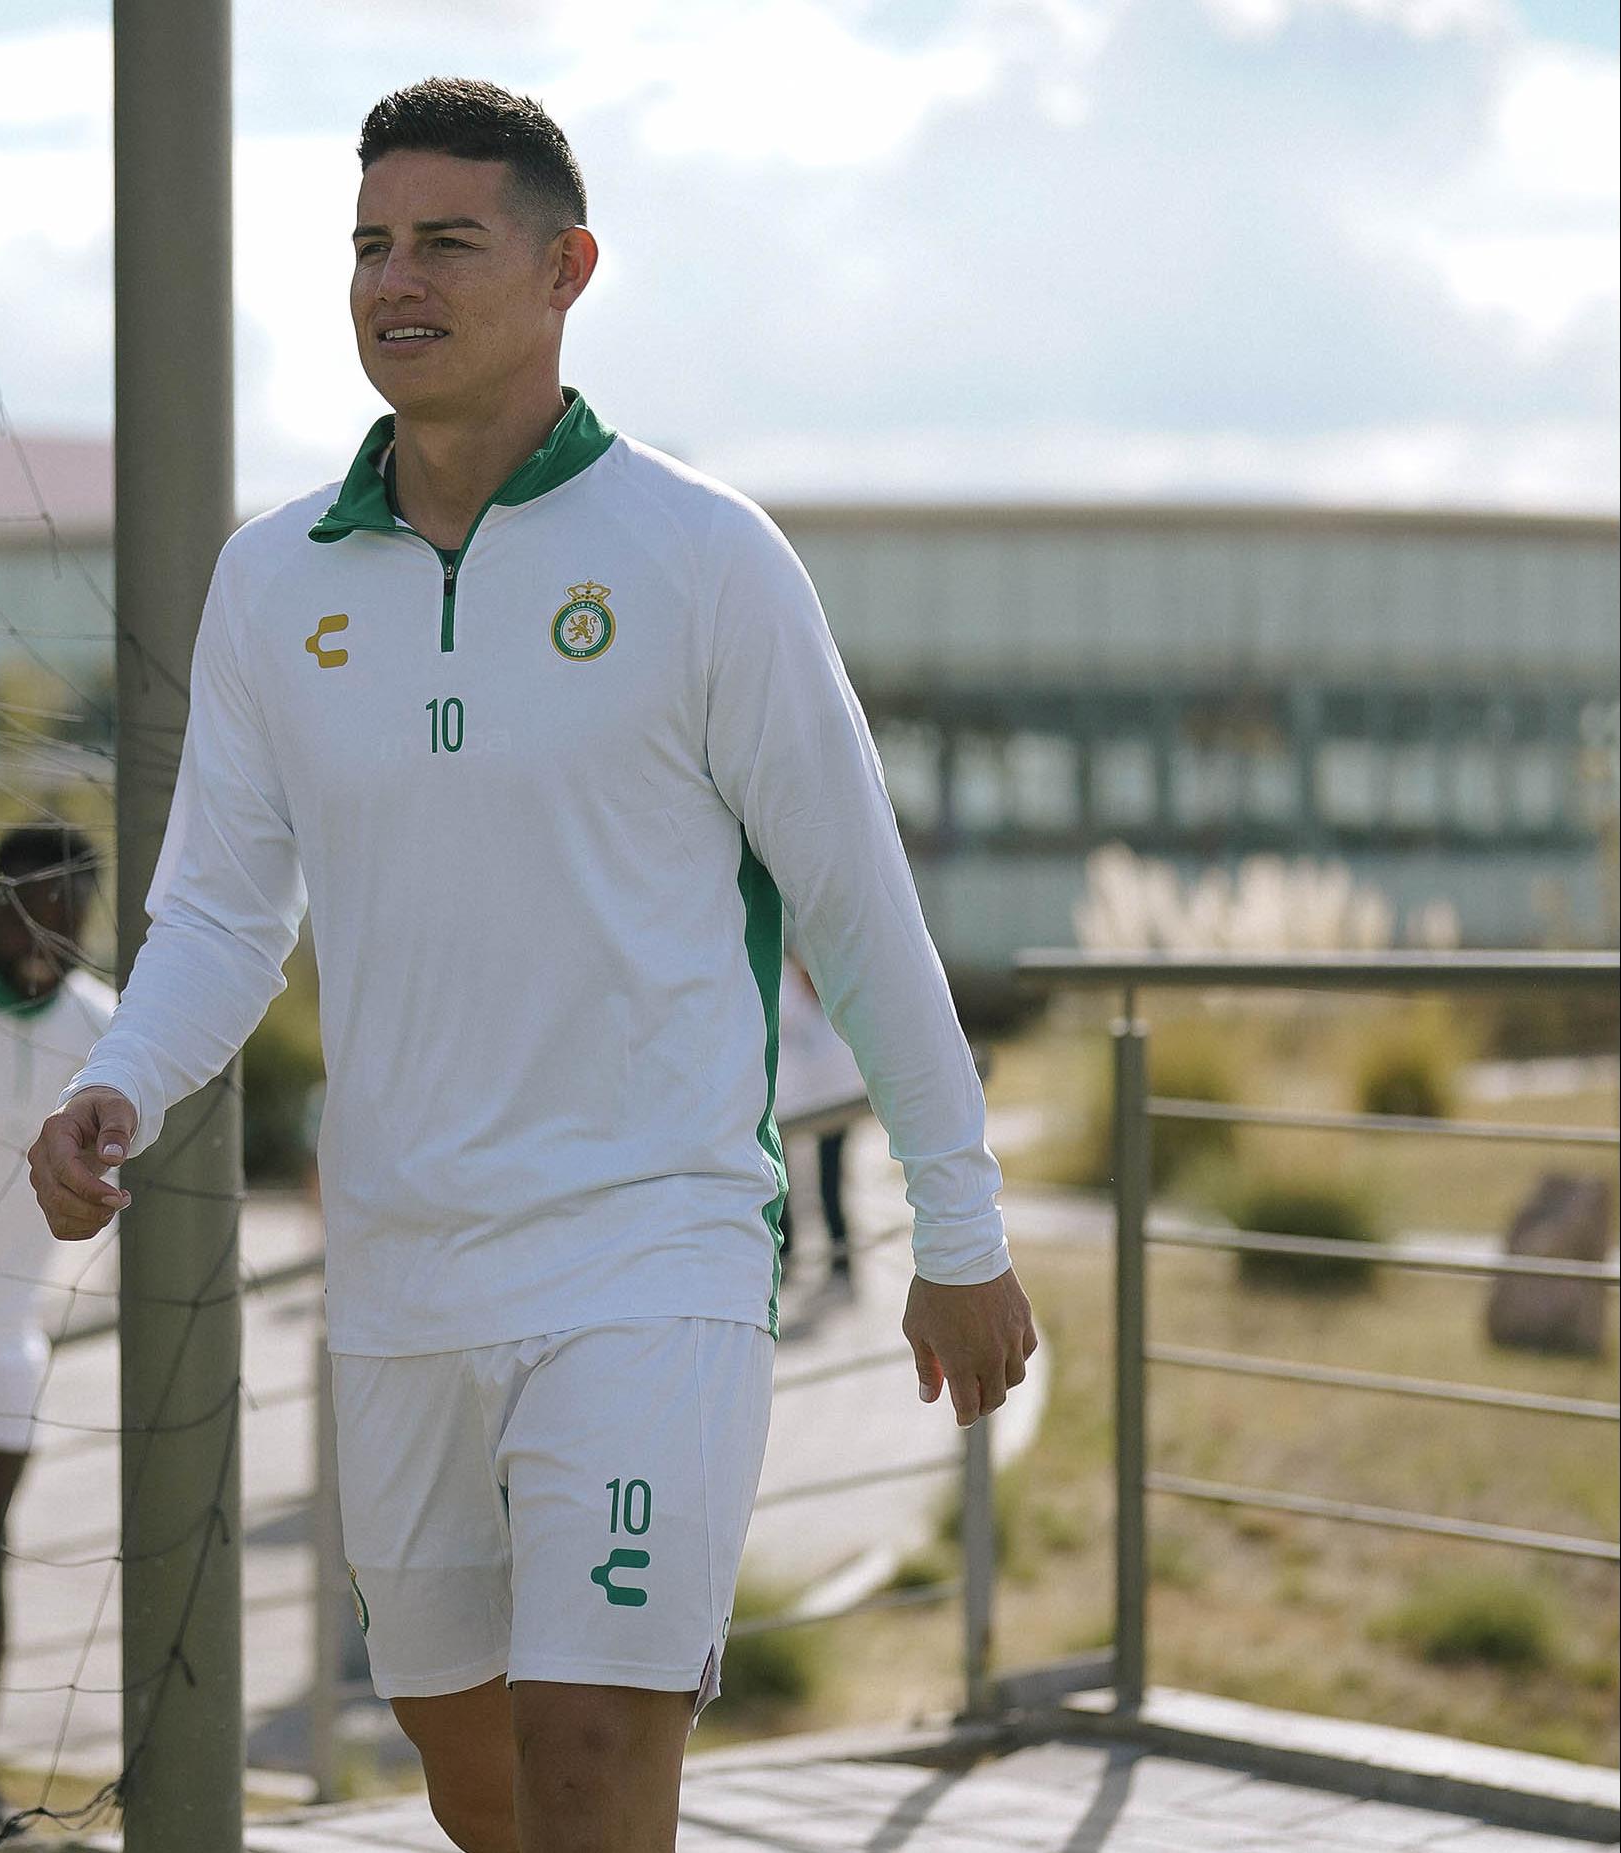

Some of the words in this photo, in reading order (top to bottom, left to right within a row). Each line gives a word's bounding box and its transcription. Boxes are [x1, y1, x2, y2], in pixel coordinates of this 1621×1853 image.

[568, 602, 585, 611] CLUB
[425, 698, 464, 753] 10
[605, 1478, 652, 1535] 10
